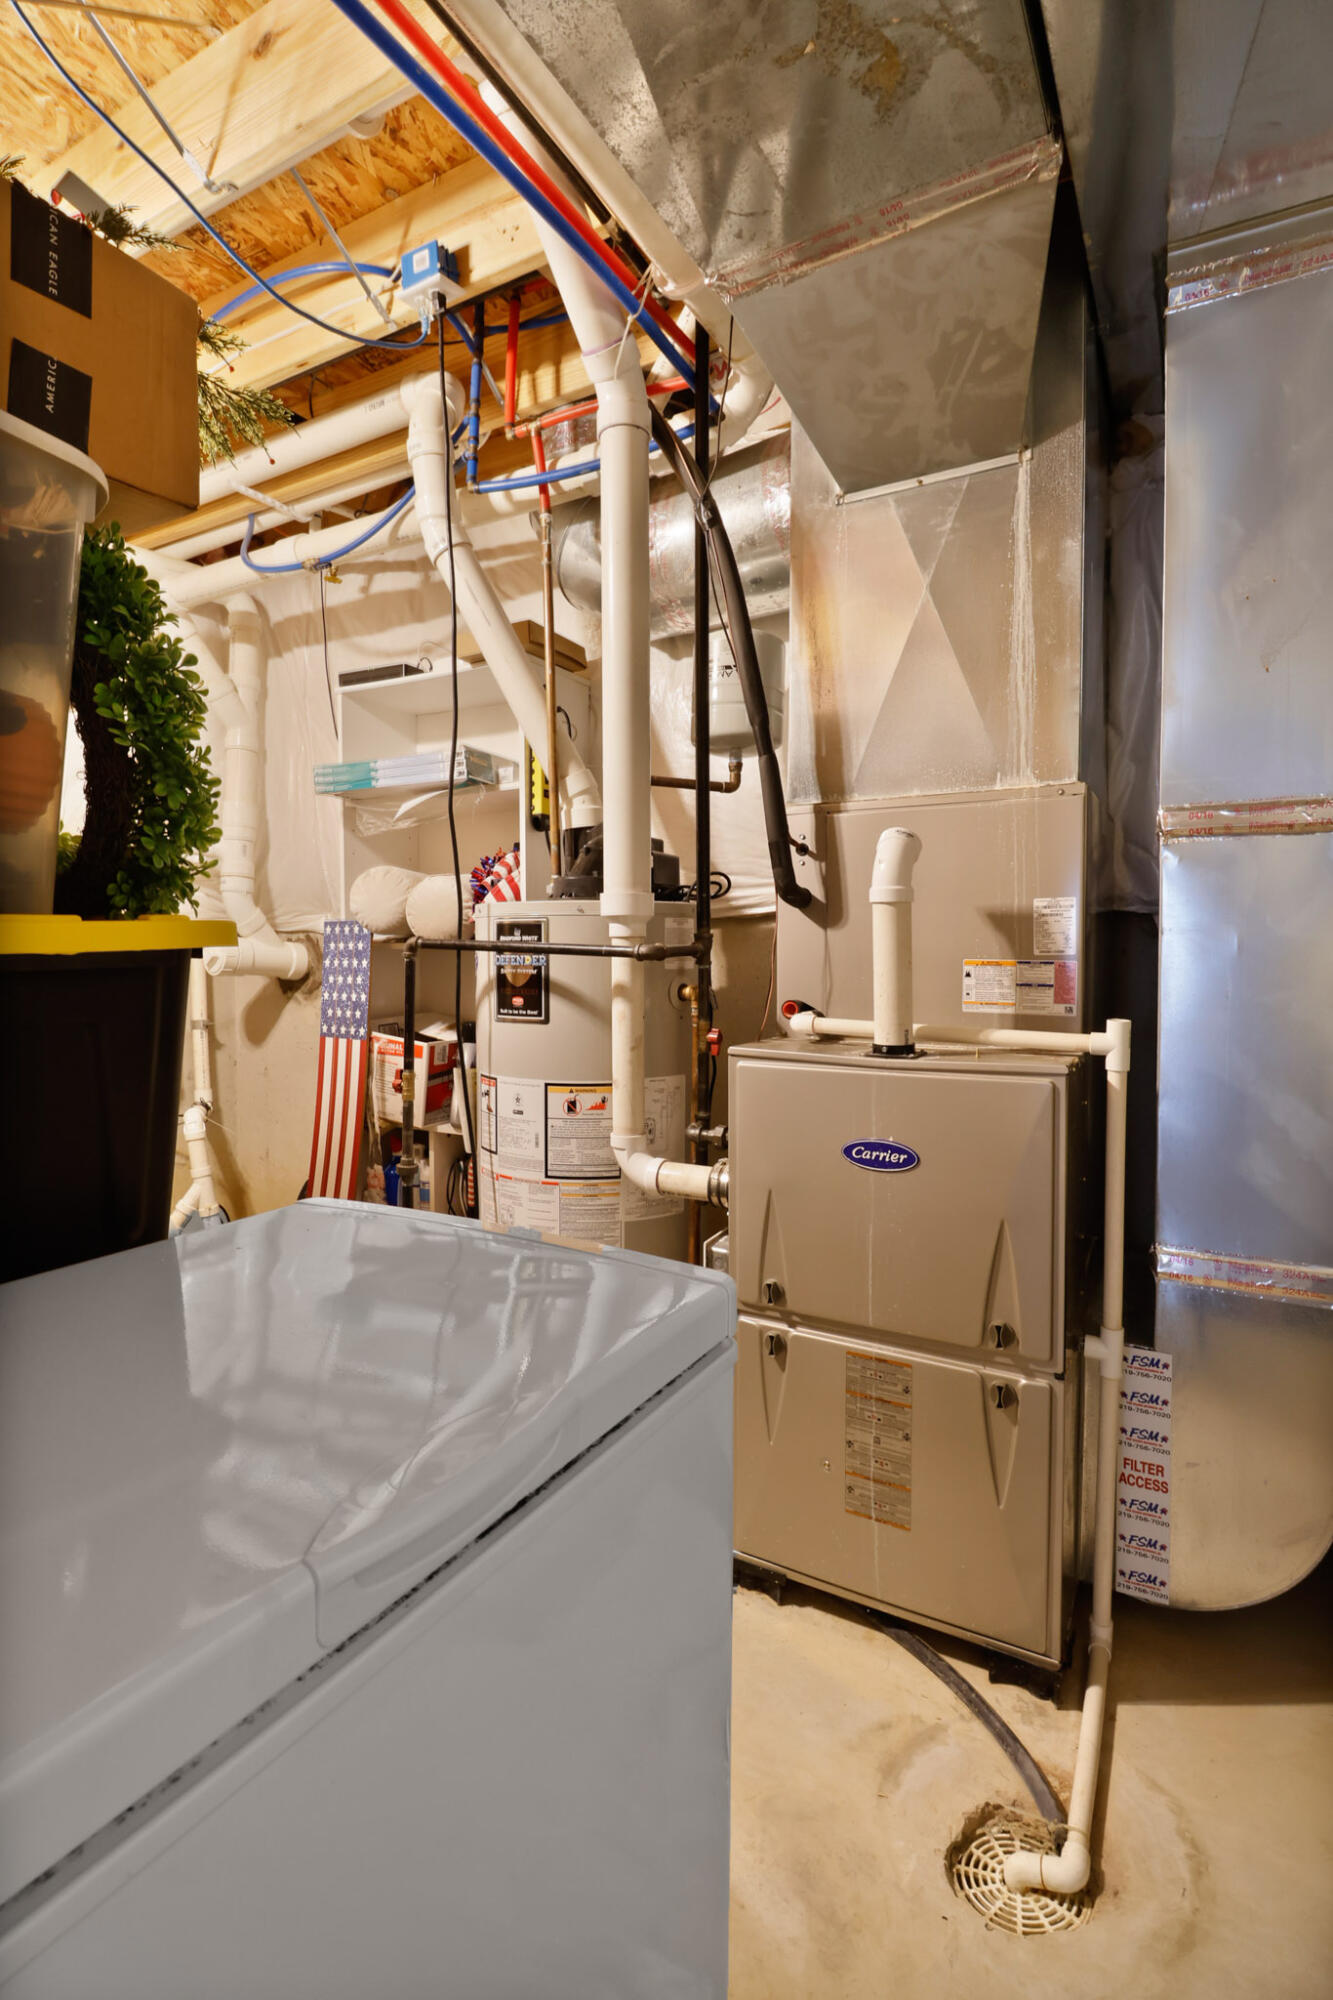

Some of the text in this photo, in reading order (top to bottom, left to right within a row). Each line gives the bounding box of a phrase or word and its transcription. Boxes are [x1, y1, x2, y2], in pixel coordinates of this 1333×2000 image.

[48, 250, 59, 296] EAGLE
[45, 357, 58, 414] AMERIC
[496, 954, 547, 966] DEFENDER
[852, 1146, 908, 1163] Carrier
[1130, 1354, 1161, 1369] FSM
[1124, 1368, 1172, 1383] 19-756-7020
[1130, 1391, 1160, 1406] FSM
[1129, 1427, 1160, 1442] FSM
[1123, 1456, 1165, 1478] FILTER
[1118, 1471, 1169, 1494] ACCESS
[1128, 1498, 1159, 1514] FSM
[1128, 1534, 1158, 1550] FSM
[1128, 1570, 1158, 1586] FSM
